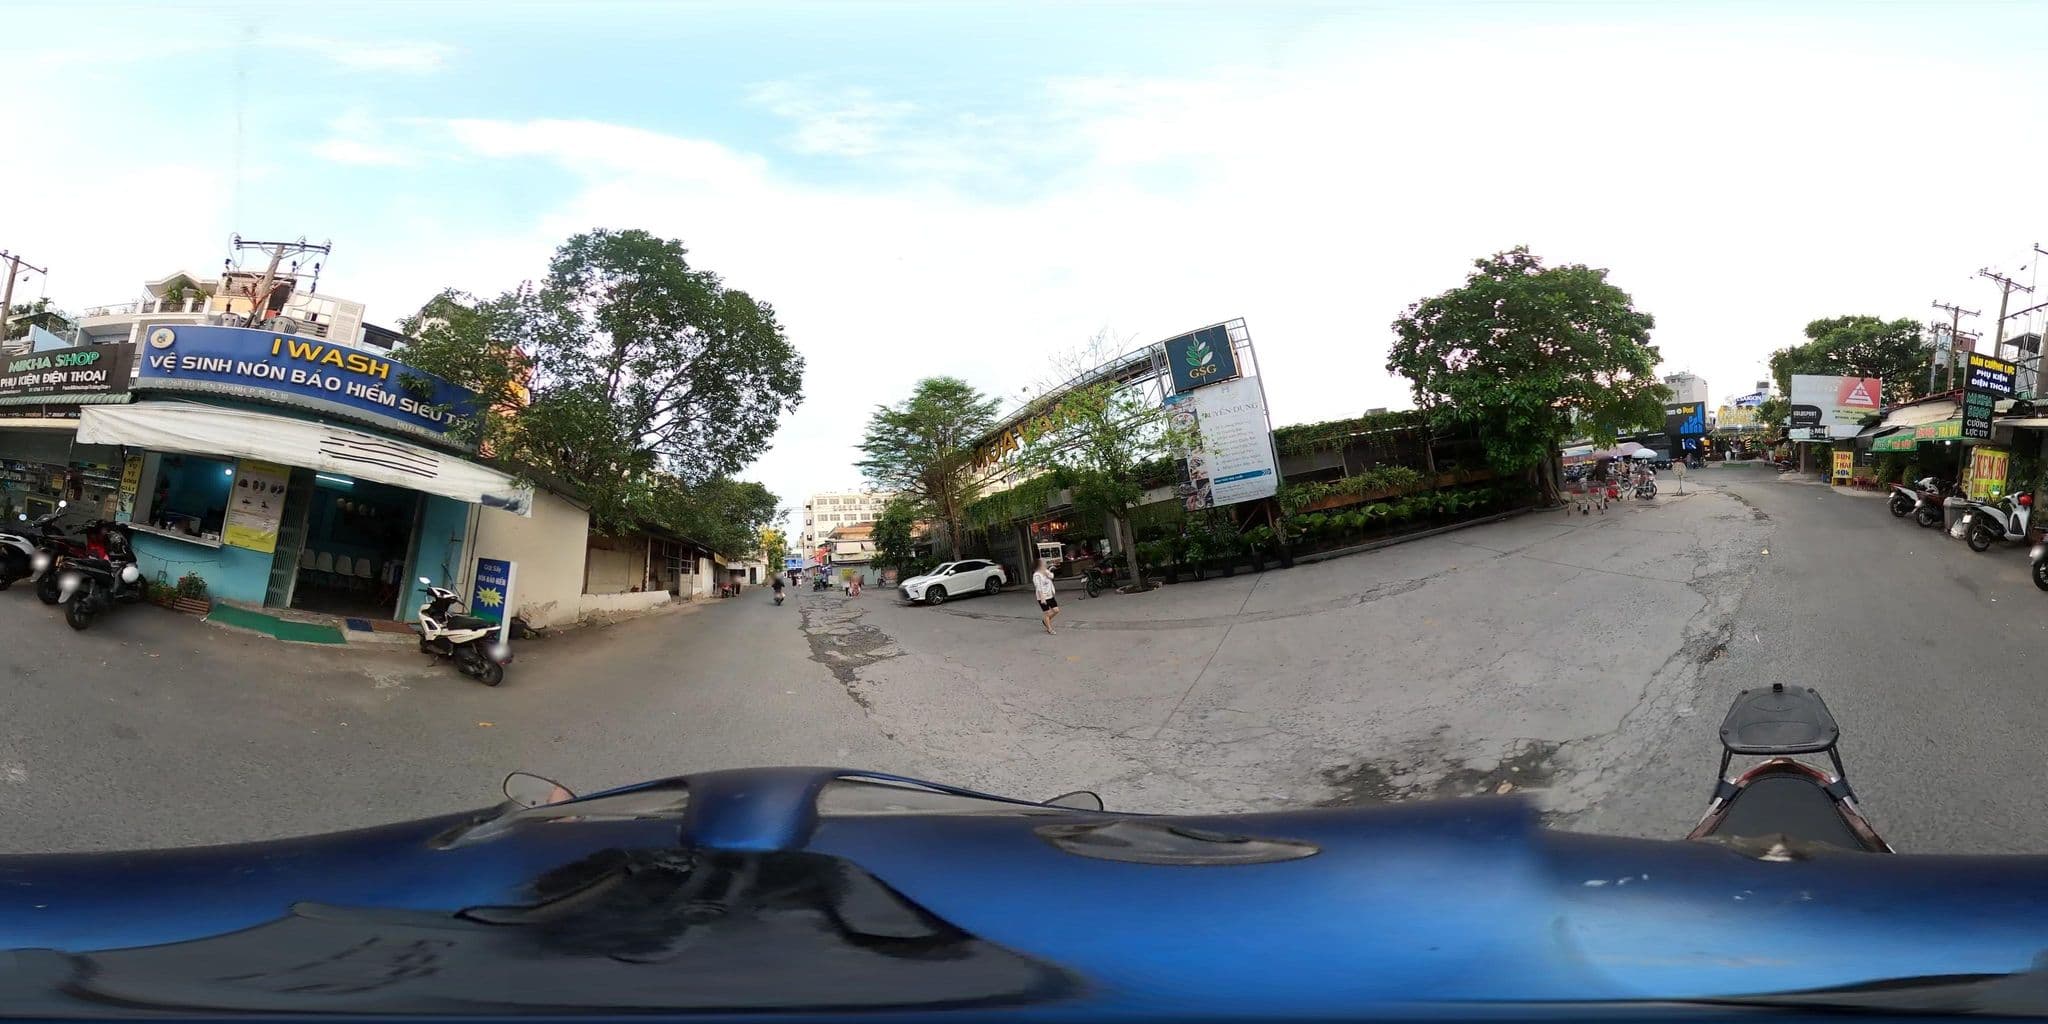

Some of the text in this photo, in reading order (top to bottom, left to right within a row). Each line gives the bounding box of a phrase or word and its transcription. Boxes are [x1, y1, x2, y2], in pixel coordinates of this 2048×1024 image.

[9, 351, 99, 372] MIKHA SHOP
[271, 338, 390, 380] I WASH
[0, 370, 107, 389] PHỤ KIỆN ĐIỆN THOẠI
[150, 352, 176, 373] VỆ
[181, 356, 233, 373] SINH
[237, 359, 286, 381] NÓN
[291, 369, 341, 391] BẢO
[346, 382, 395, 406] HIỂM
[1189, 364, 1216, 378] GSG
[1976, 369, 1992, 378] PHỤ
[1971, 378, 2010, 393] ĐIỆN THOẠI
